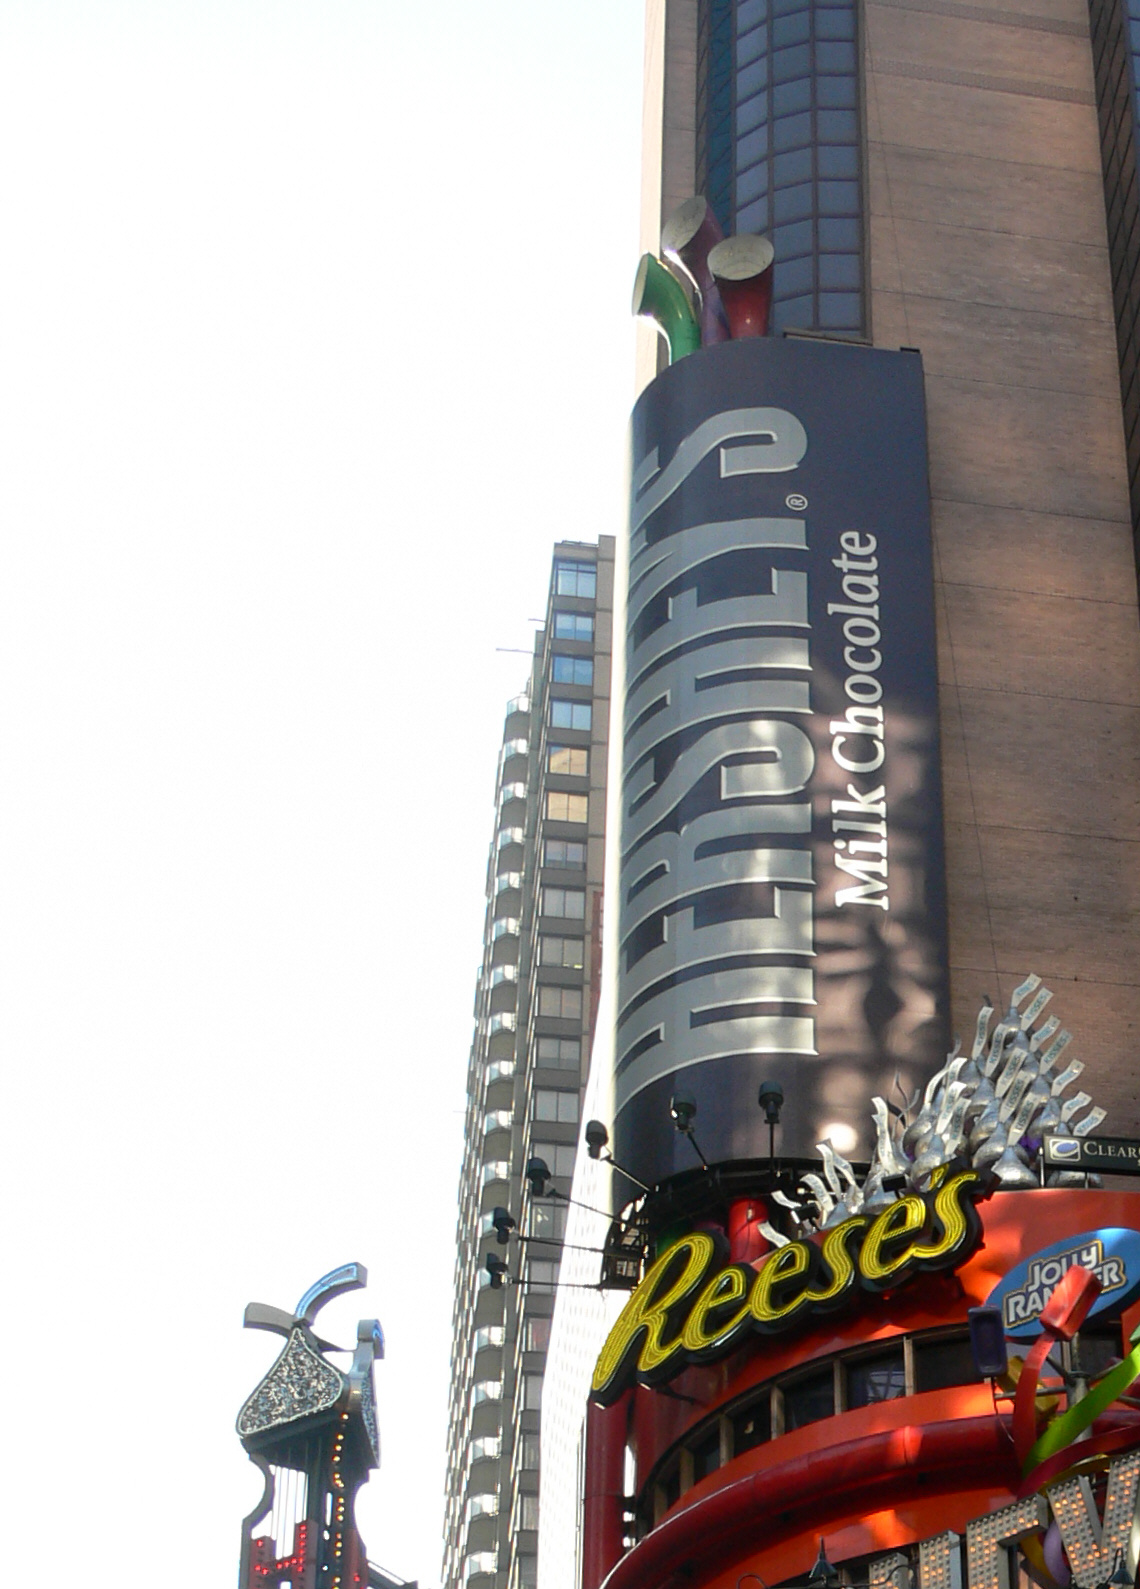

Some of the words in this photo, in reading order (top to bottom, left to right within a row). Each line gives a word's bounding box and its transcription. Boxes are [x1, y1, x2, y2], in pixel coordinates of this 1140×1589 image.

[612, 406, 819, 1106] HERSHEY'S
[828, 530, 886, 774] Chocolate
[834, 785, 889, 910] Milk
[592, 1163, 980, 1392] Reese's
